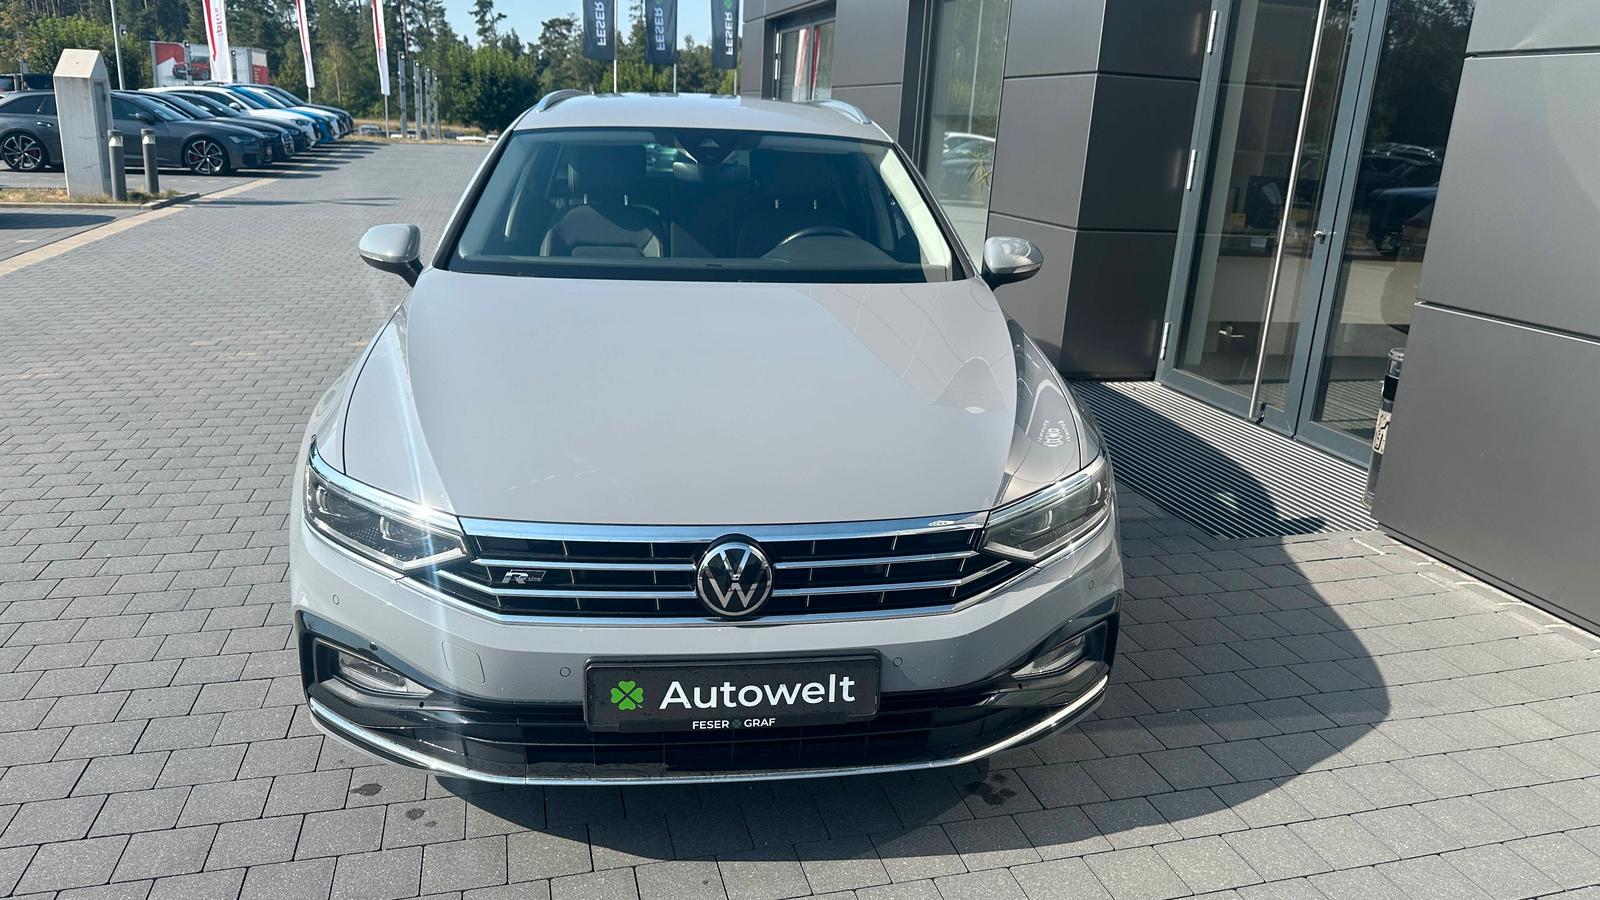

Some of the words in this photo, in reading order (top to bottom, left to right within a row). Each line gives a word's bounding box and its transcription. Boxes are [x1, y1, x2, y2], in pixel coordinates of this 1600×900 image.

[501, 571, 528, 584] R
[659, 673, 856, 710] Autowelt
[692, 719, 729, 730] FESER
[744, 717, 776, 728] GRAF
